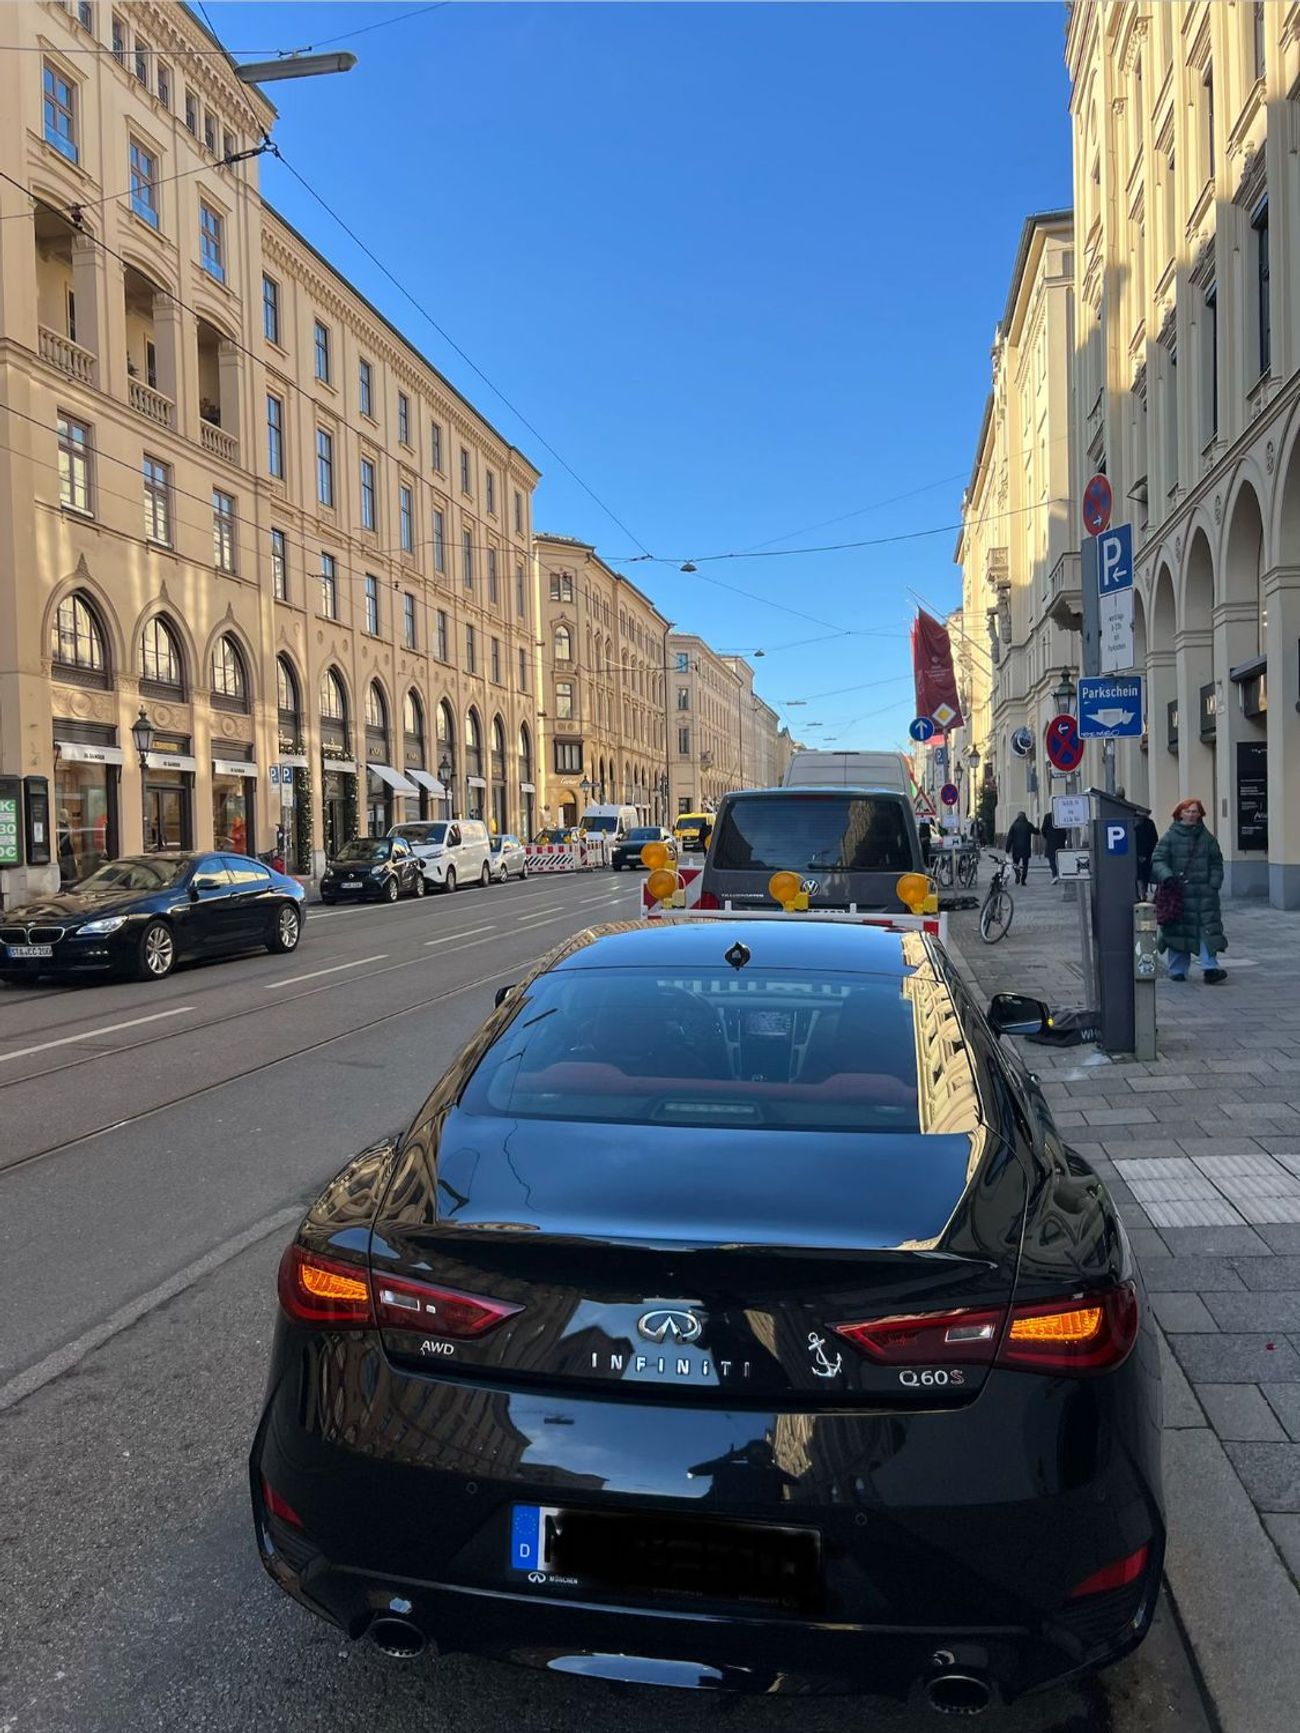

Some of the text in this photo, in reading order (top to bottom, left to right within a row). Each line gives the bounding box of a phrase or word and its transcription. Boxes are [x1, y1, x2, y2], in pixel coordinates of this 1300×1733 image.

[1103, 537, 1122, 586] P
[1082, 685, 1139, 699] Parkschein
[1107, 826, 1125, 849] P
[420, 1340, 455, 1356] AWD
[591, 1352, 750, 1377] INFINITI
[899, 1369, 965, 1386] Q60S
[519, 1543, 530, 1558] D
